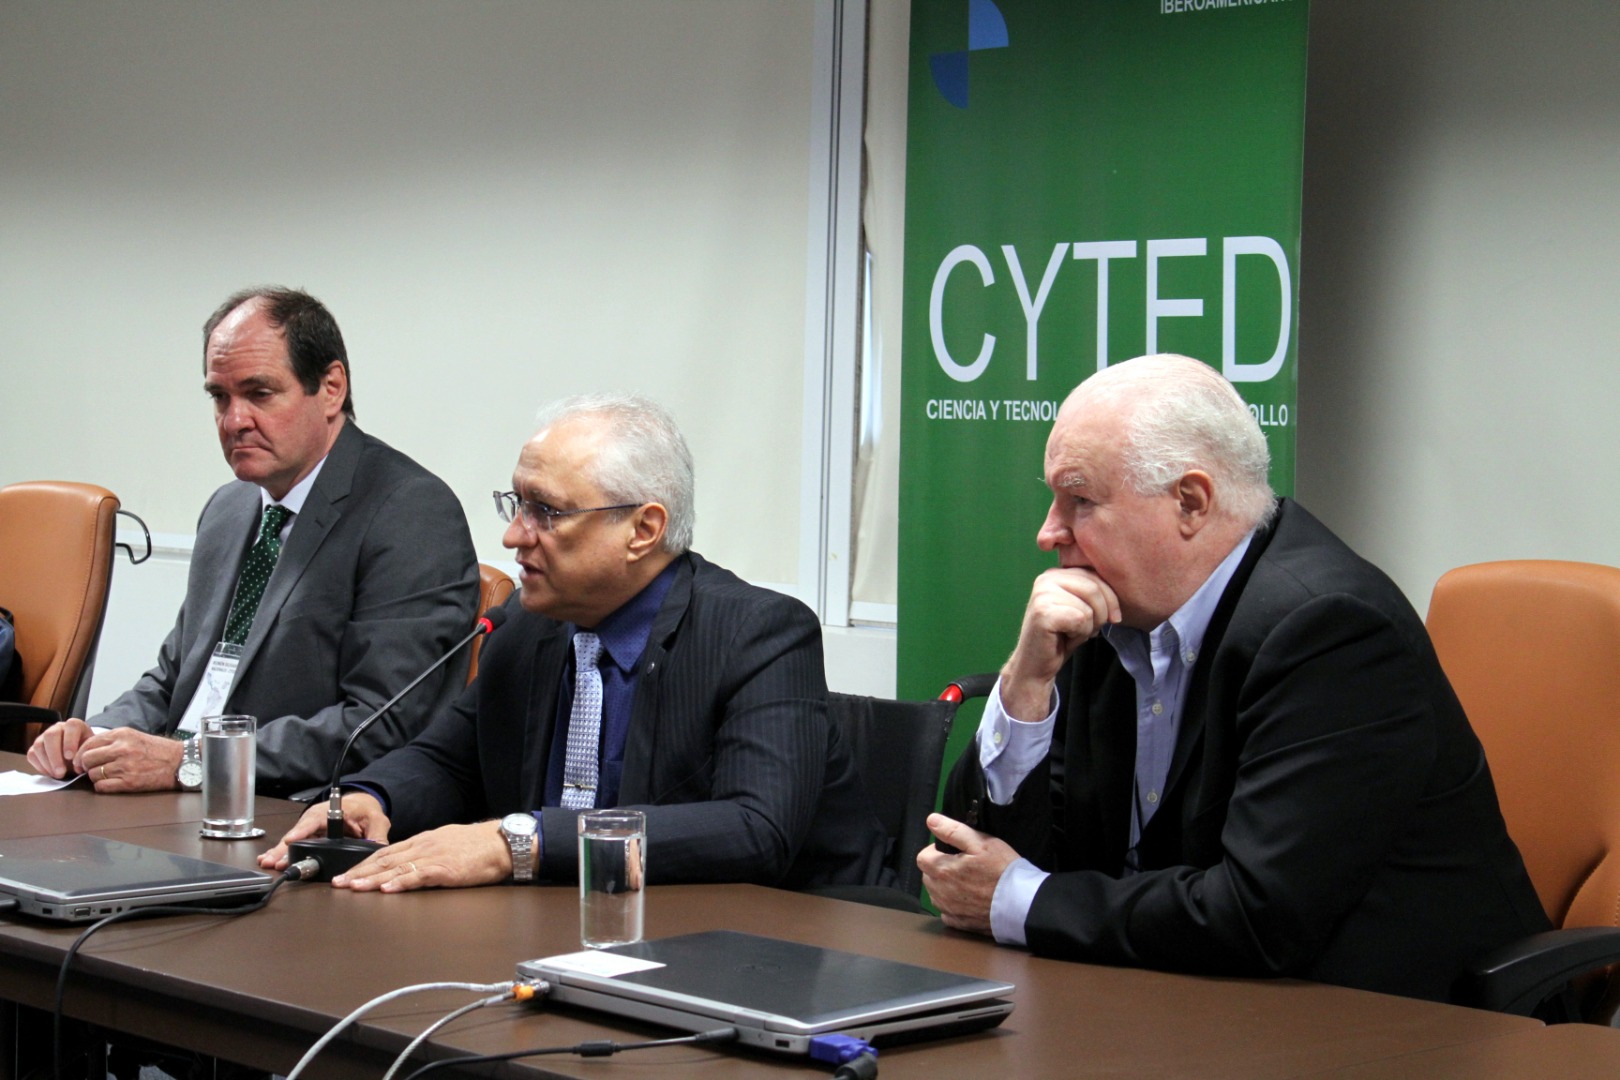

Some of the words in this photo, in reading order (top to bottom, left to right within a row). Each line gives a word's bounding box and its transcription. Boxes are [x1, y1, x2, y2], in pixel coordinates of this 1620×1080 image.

[929, 235, 1292, 382] CYTED
[926, 399, 987, 420] CIENCIA
[989, 400, 1000, 420] Y
